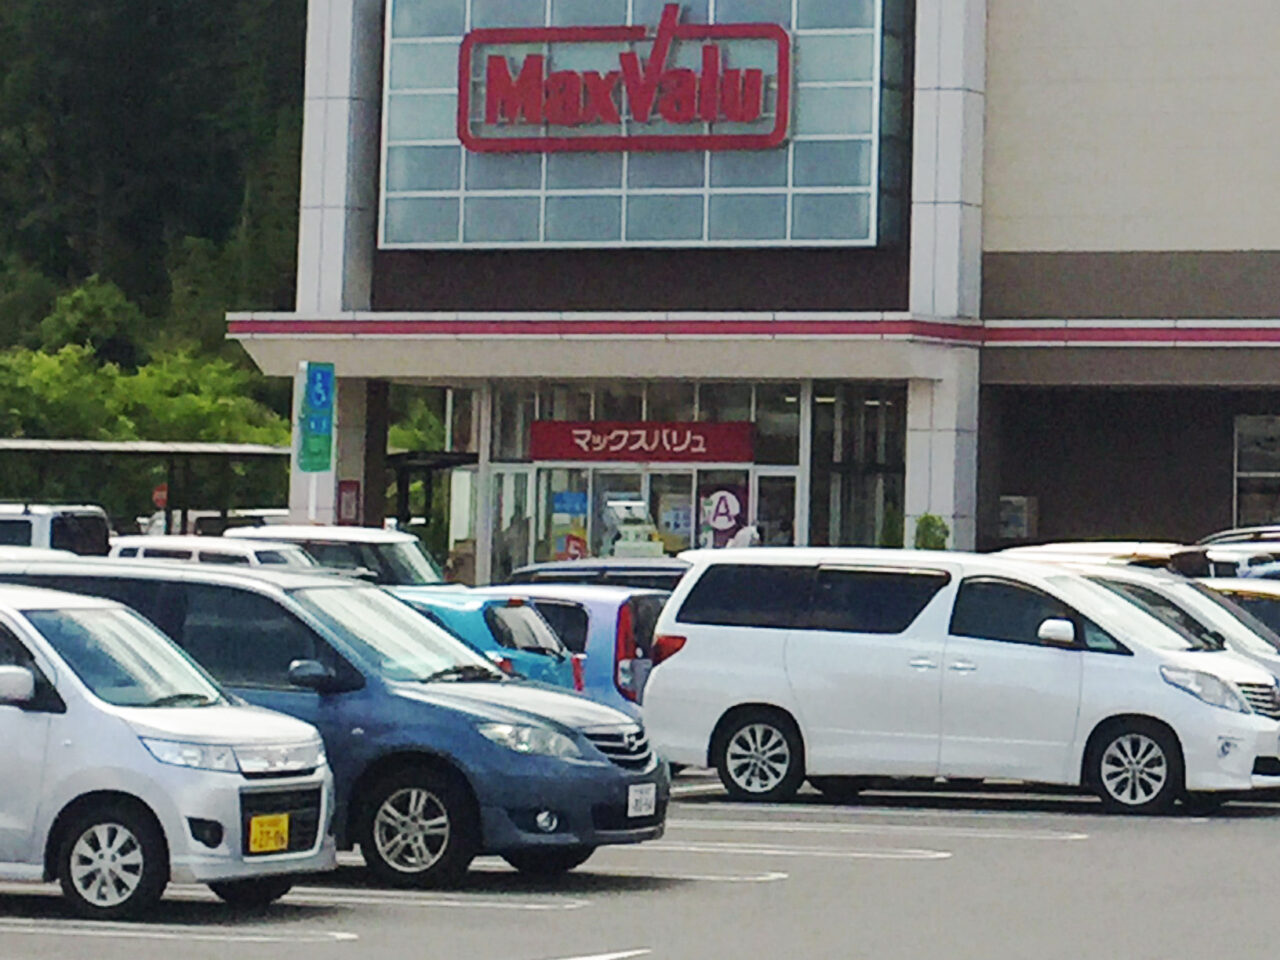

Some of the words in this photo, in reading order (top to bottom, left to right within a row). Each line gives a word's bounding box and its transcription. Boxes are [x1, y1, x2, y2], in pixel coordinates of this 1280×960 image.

[486, 3, 762, 124] MaxValu
[572, 429, 706, 453] マックスバリュ
[712, 495, 732, 522] A
